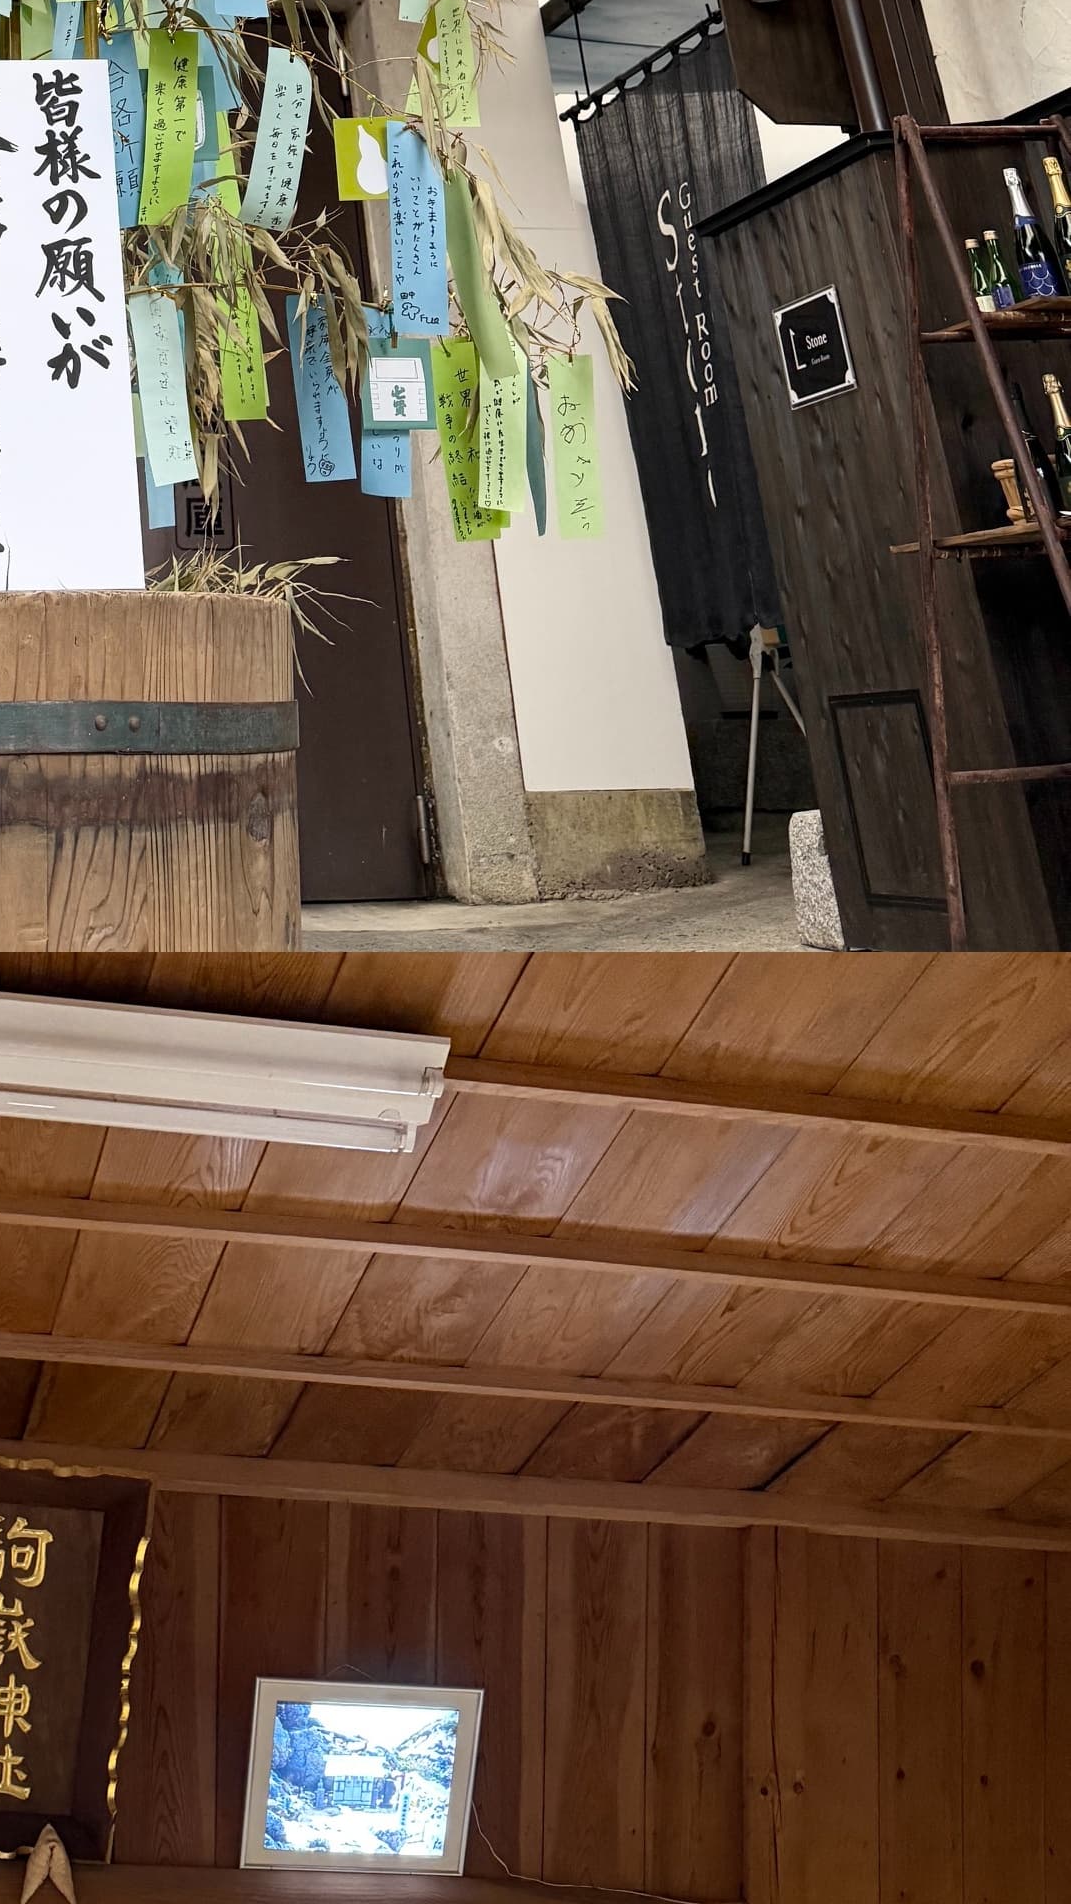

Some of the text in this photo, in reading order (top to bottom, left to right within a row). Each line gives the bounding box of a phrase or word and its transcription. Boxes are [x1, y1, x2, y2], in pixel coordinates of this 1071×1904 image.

[173, 56, 189, 143] 健康第一で
[32, 70, 114, 389] 皆様の願いが
[695, 312, 718, 407] Room
[805, 332, 828, 350] Stone
[392, 385, 407, 417] 七賢
